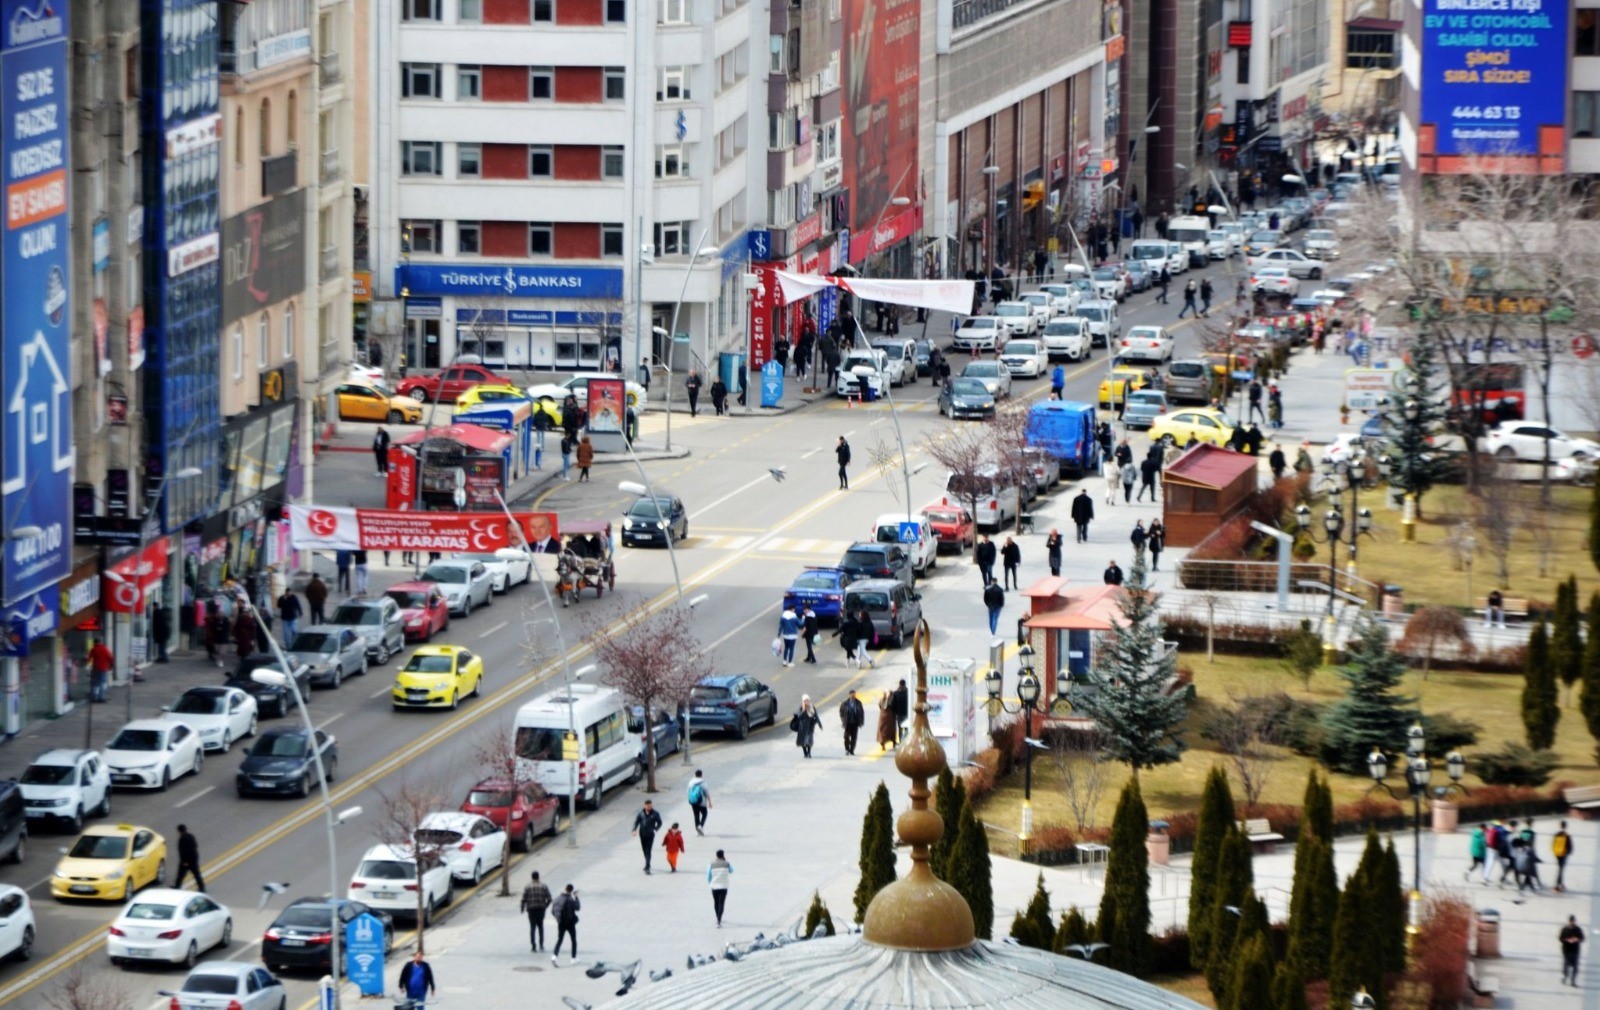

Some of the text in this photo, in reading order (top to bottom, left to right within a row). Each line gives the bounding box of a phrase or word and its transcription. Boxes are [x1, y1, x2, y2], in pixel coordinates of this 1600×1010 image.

[1425, 12, 1553, 28] EV VE OTOMOBİL
[1438, 31, 1489, 46] SAHİBİ
[1465, 49, 1510, 68] ŞİMDİ
[1444, 70, 1480, 83] SIRA
[1452, 106, 1481, 119] 444
[441, 272, 502, 287] TÜRKİYE
[519, 276, 582, 288] BANKASI
[361, 518, 408, 527] ERZURUM
[363, 526, 427, 535] MİLLETVEKİLİ
[363, 536, 470, 550] NAM KARATAŞ
